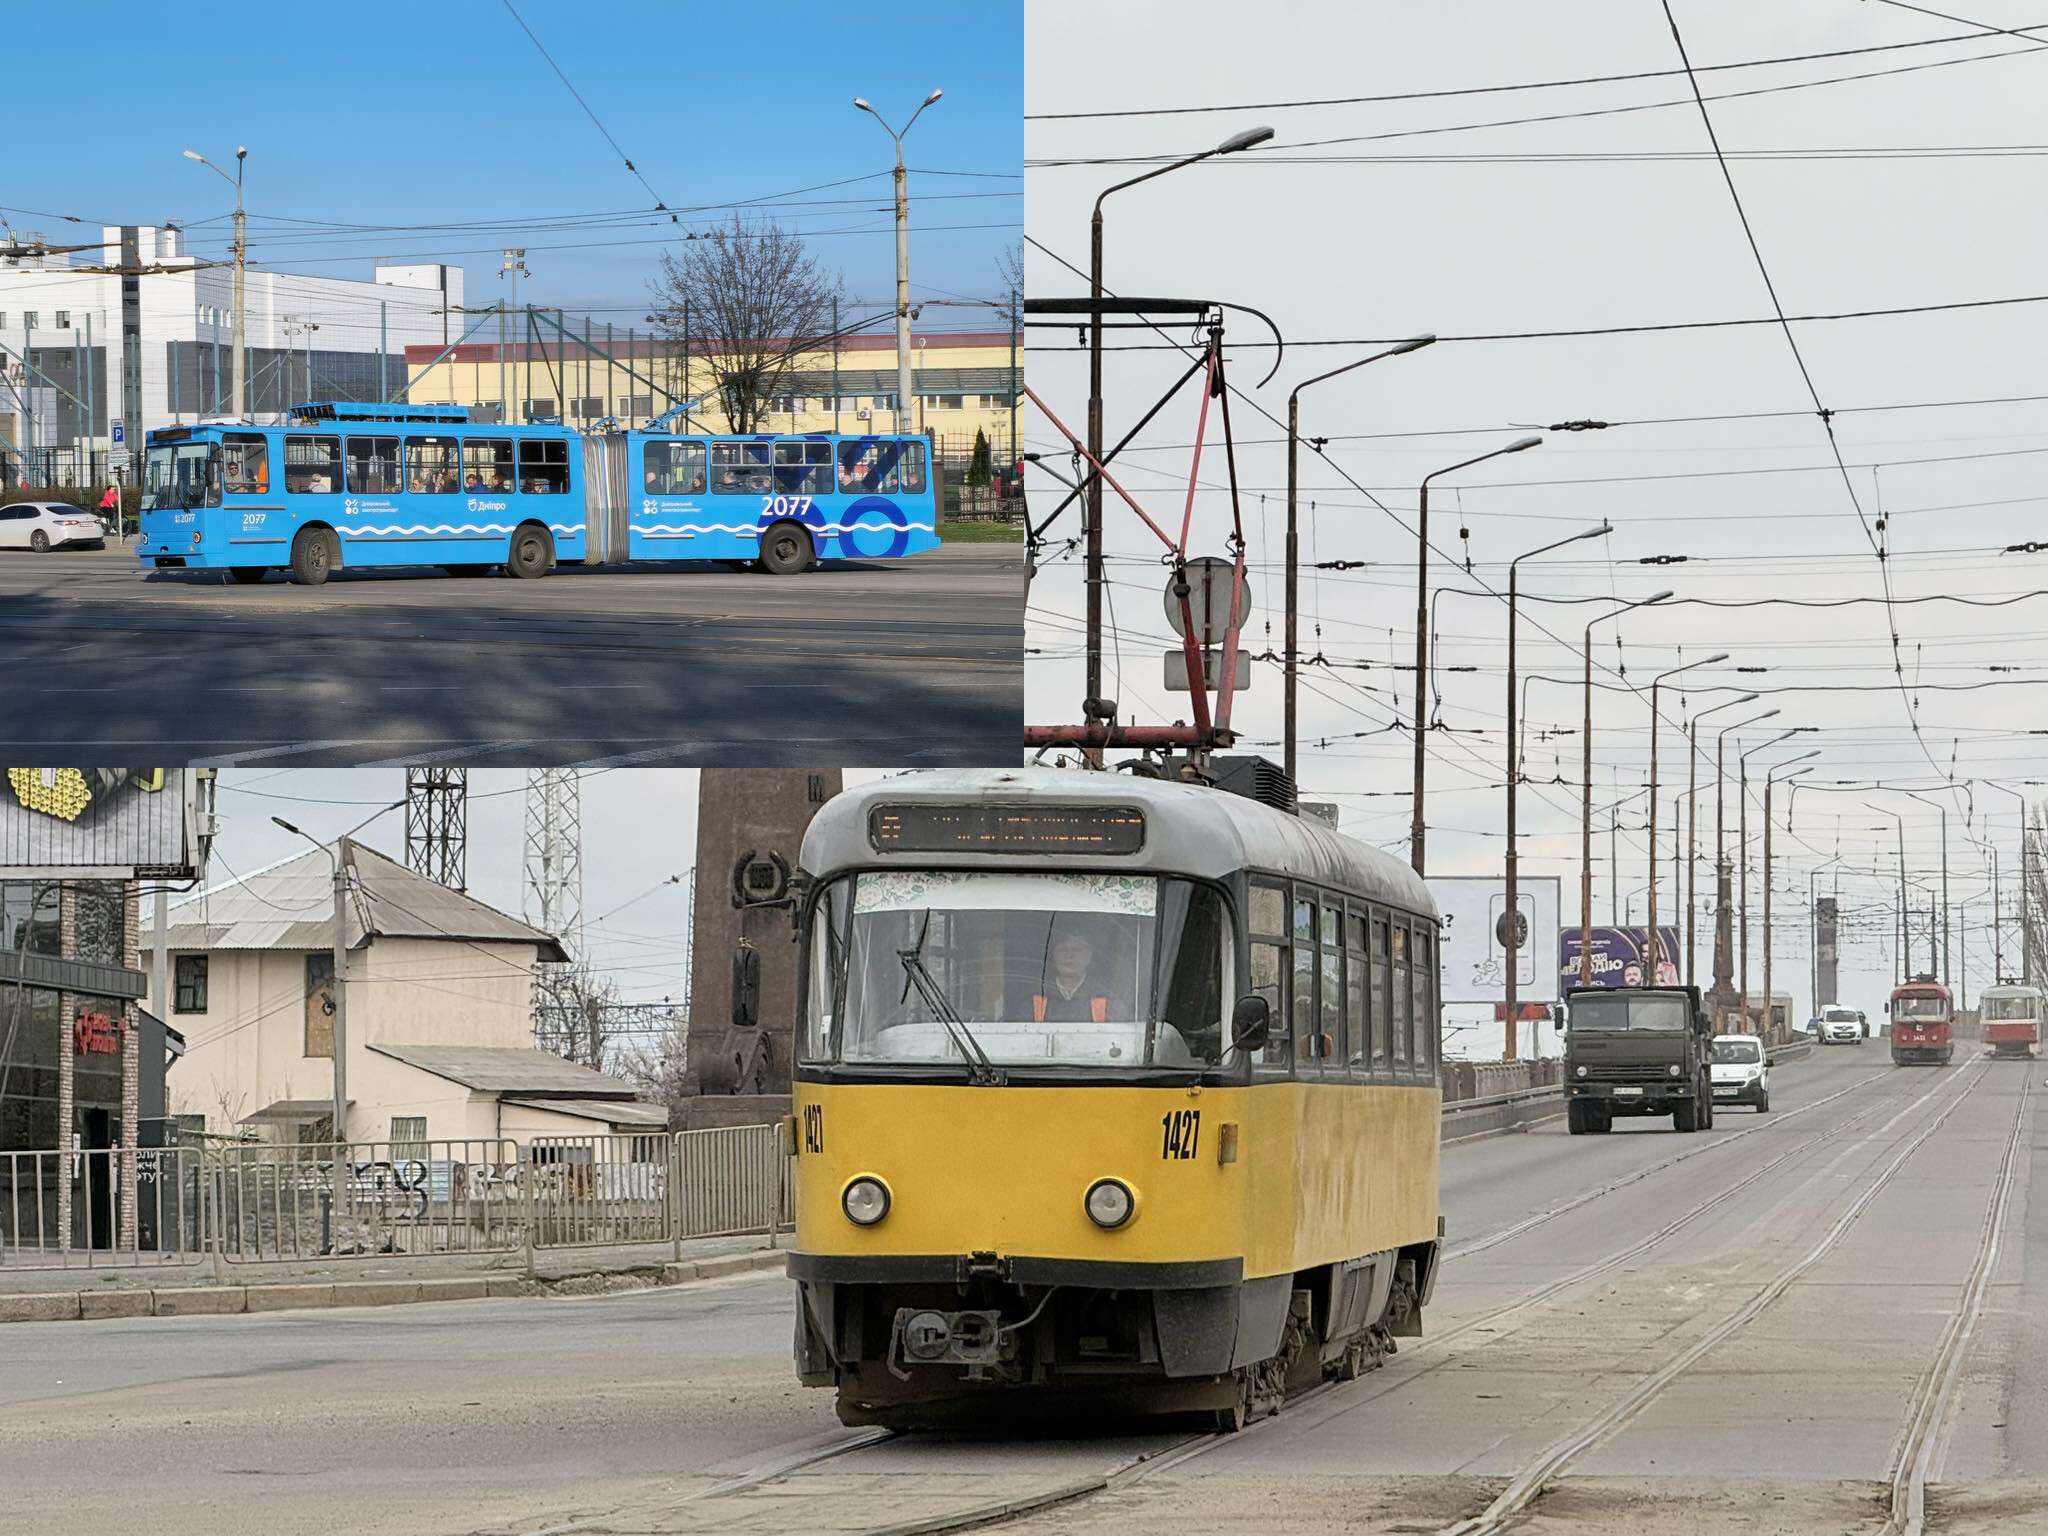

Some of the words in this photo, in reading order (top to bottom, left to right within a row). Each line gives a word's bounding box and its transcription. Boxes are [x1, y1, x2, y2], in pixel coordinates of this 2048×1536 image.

[478, 501, 506, 512] Дніпро
[762, 496, 812, 516] 2077
[180, 513, 196, 523] 2077
[242, 514, 266, 524] 2077
[804, 1104, 823, 1153] 1427
[1162, 1109, 1200, 1160] 1427
